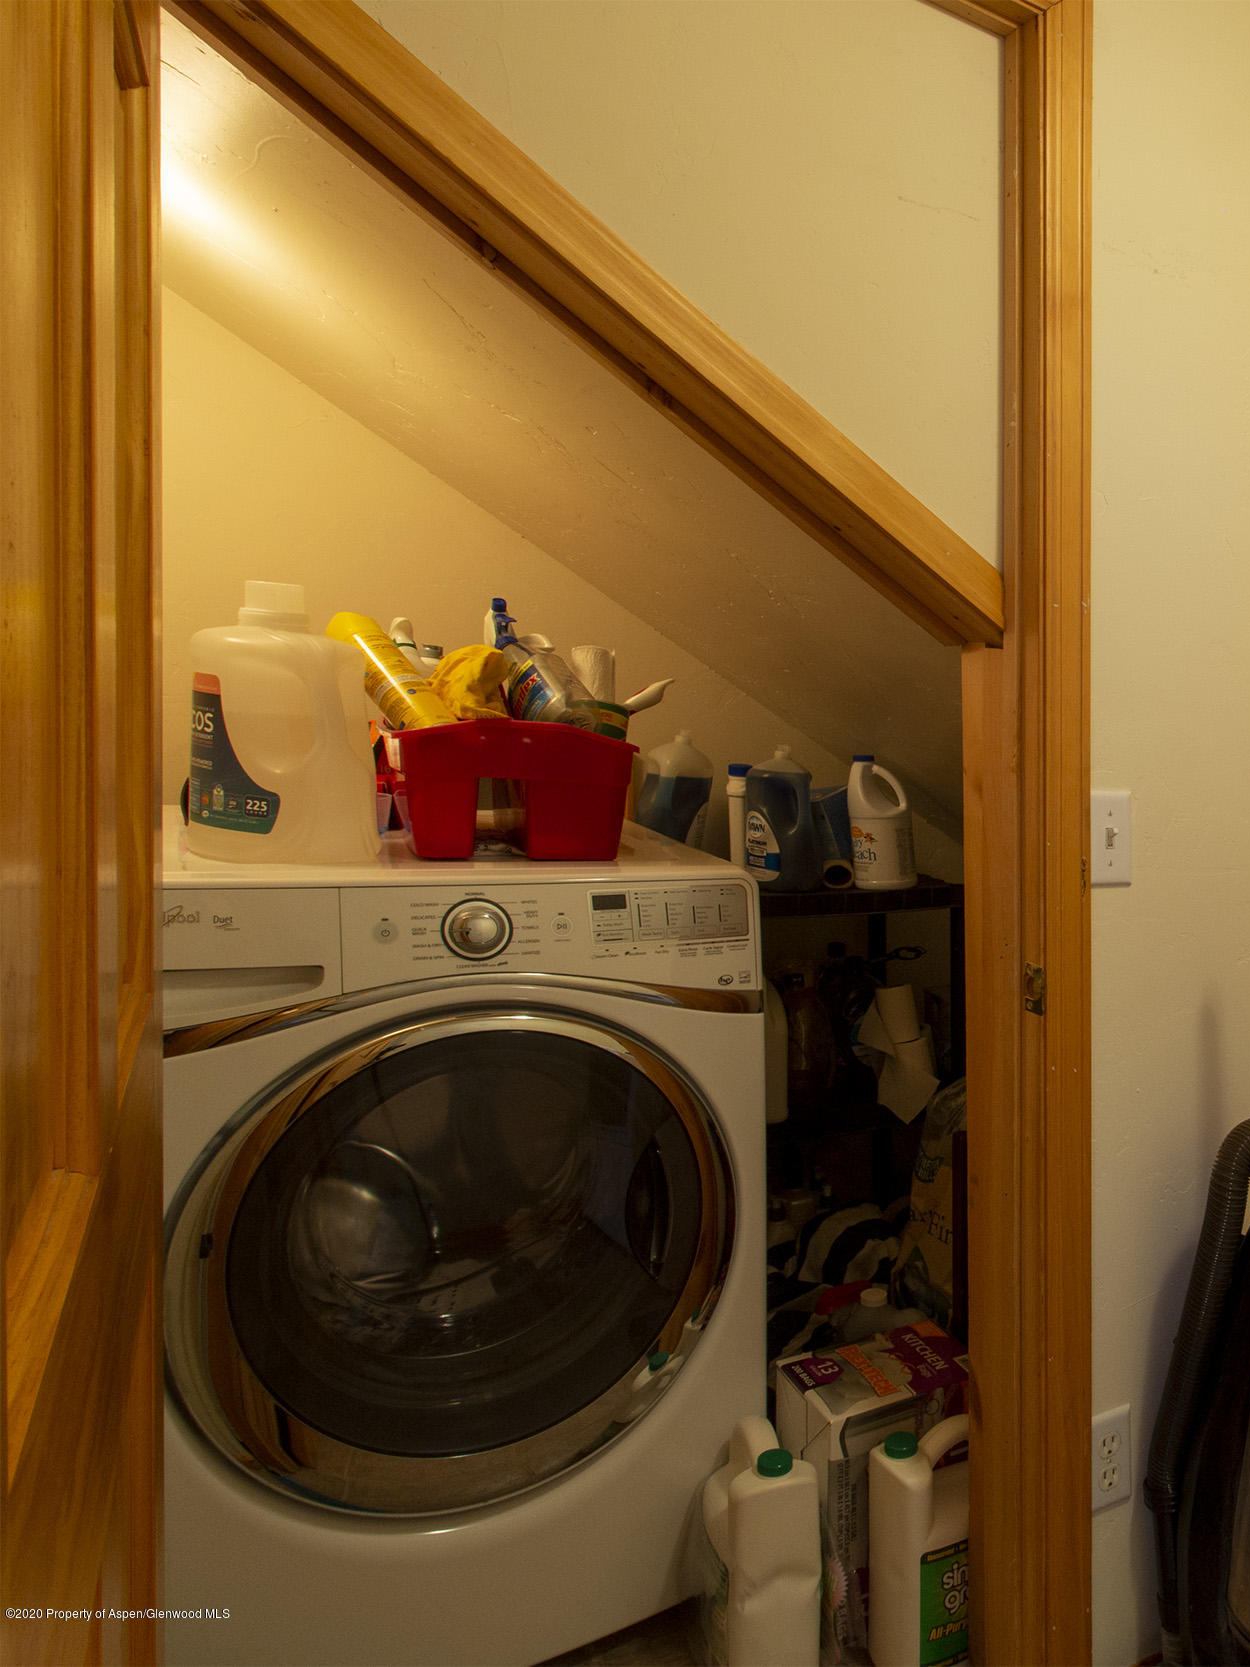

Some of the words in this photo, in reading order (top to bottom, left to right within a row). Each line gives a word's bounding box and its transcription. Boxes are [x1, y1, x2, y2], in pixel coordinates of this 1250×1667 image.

[246, 799, 268, 812] 225
[162, 909, 201, 927] lpool
[213, 914, 233, 924] Duet
[901, 1332, 949, 1371] KITCHEN
[817, 1360, 840, 1375] 13
